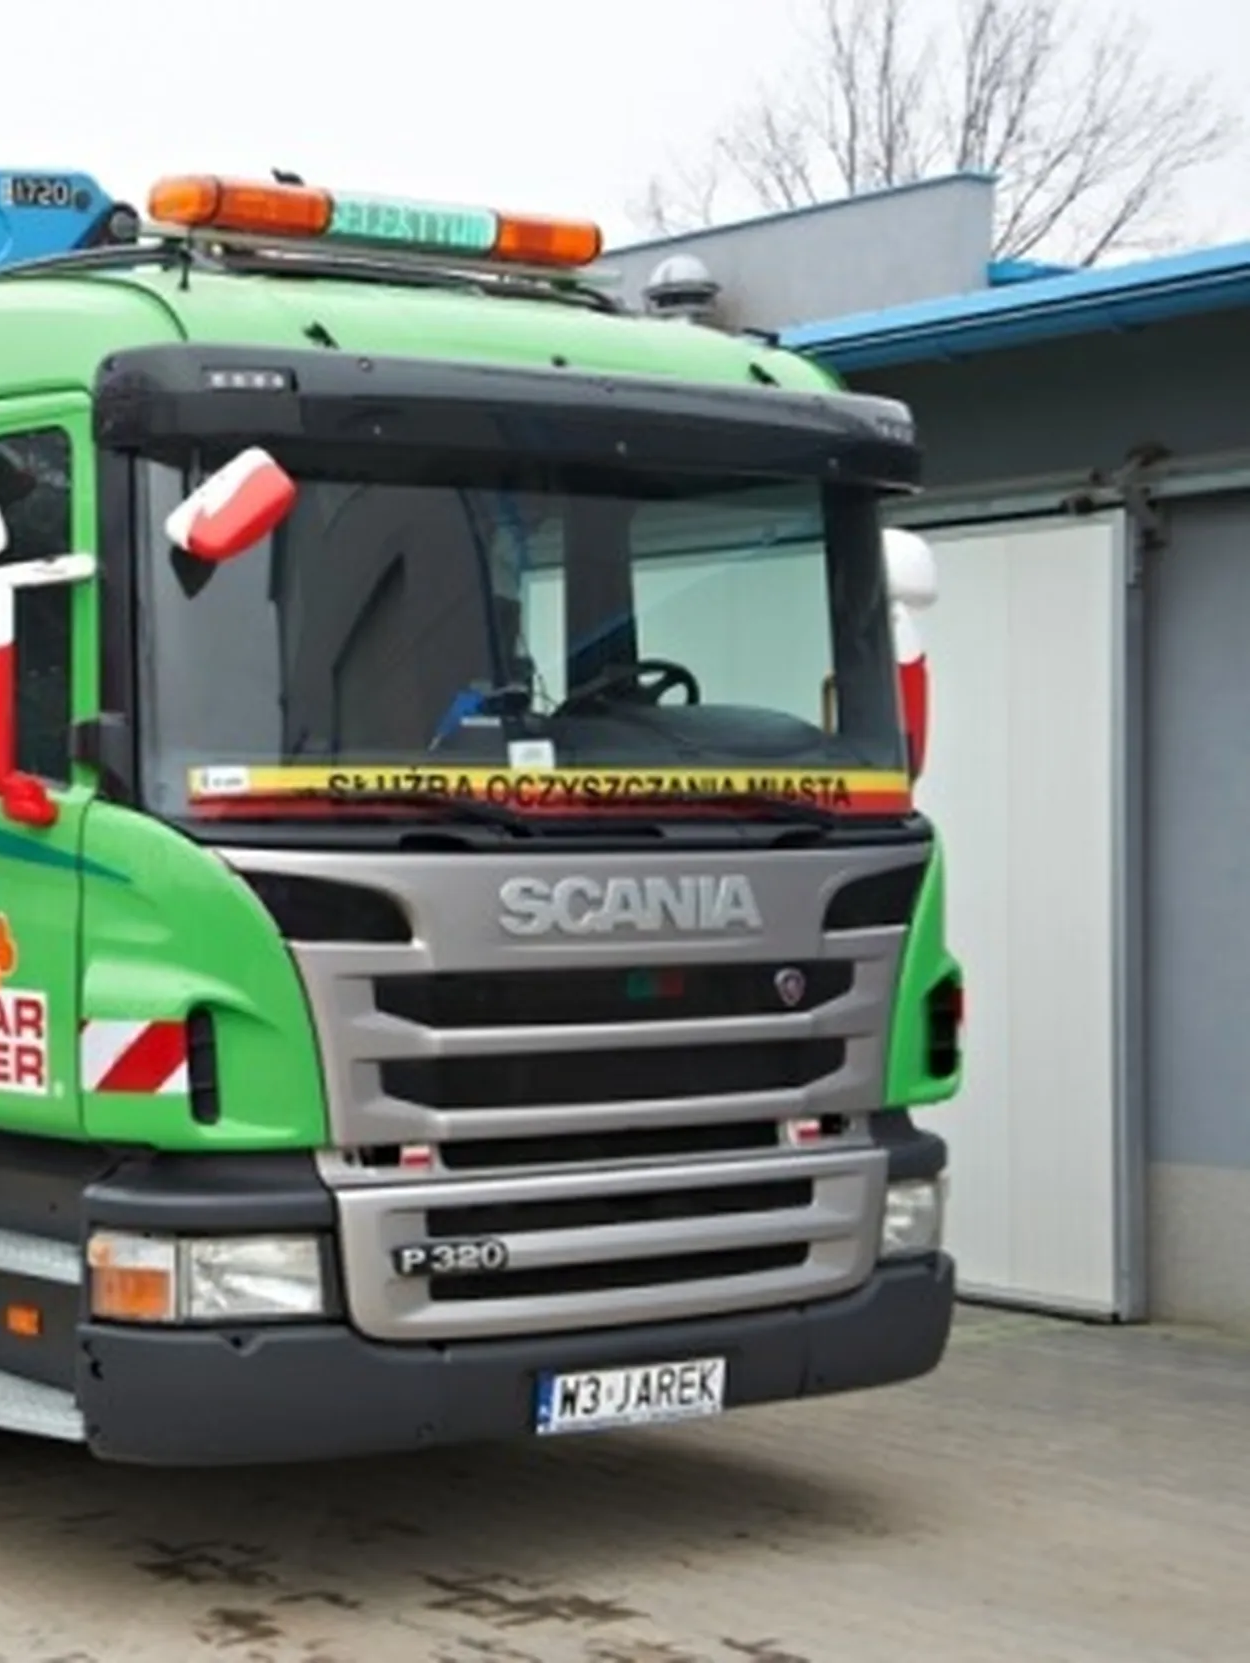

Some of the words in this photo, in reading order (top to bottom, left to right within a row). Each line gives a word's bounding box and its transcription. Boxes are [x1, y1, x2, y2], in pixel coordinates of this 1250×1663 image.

[499, 874, 762, 936] SCANIA
[401, 1248, 427, 1274] P
[430, 1240, 504, 1273] 320
[615, 1361, 719, 1414] JAREK
